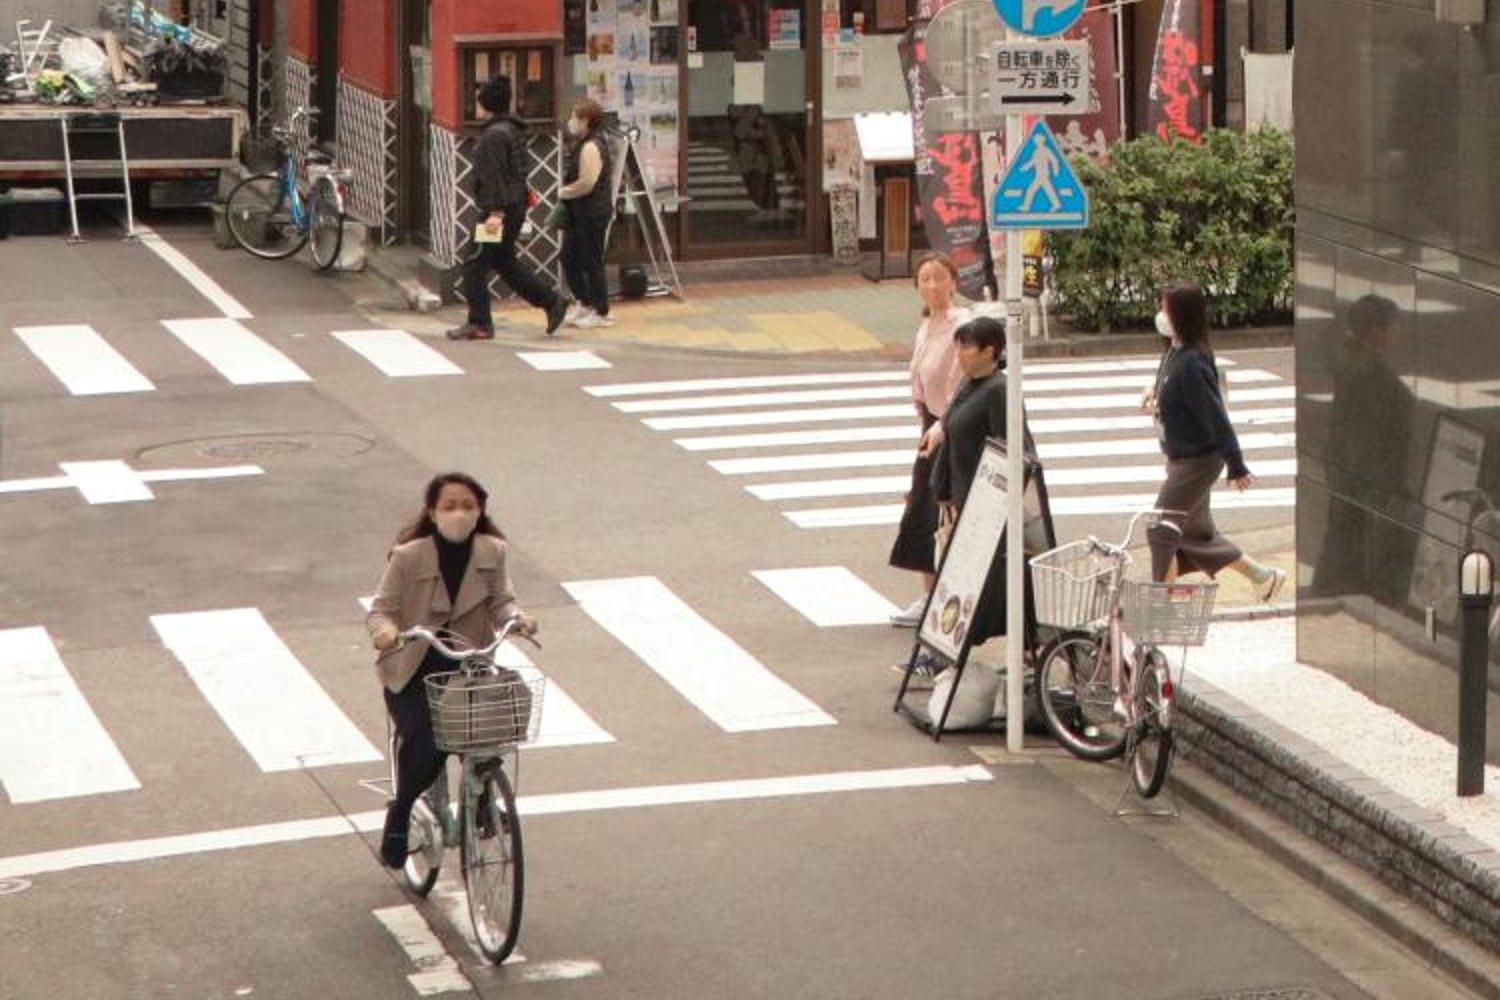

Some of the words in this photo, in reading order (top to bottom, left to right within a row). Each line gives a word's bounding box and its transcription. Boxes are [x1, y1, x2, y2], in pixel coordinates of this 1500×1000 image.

[998, 50, 1080, 70] 自転車を除く
[998, 72, 1080, 89] 一方通行
